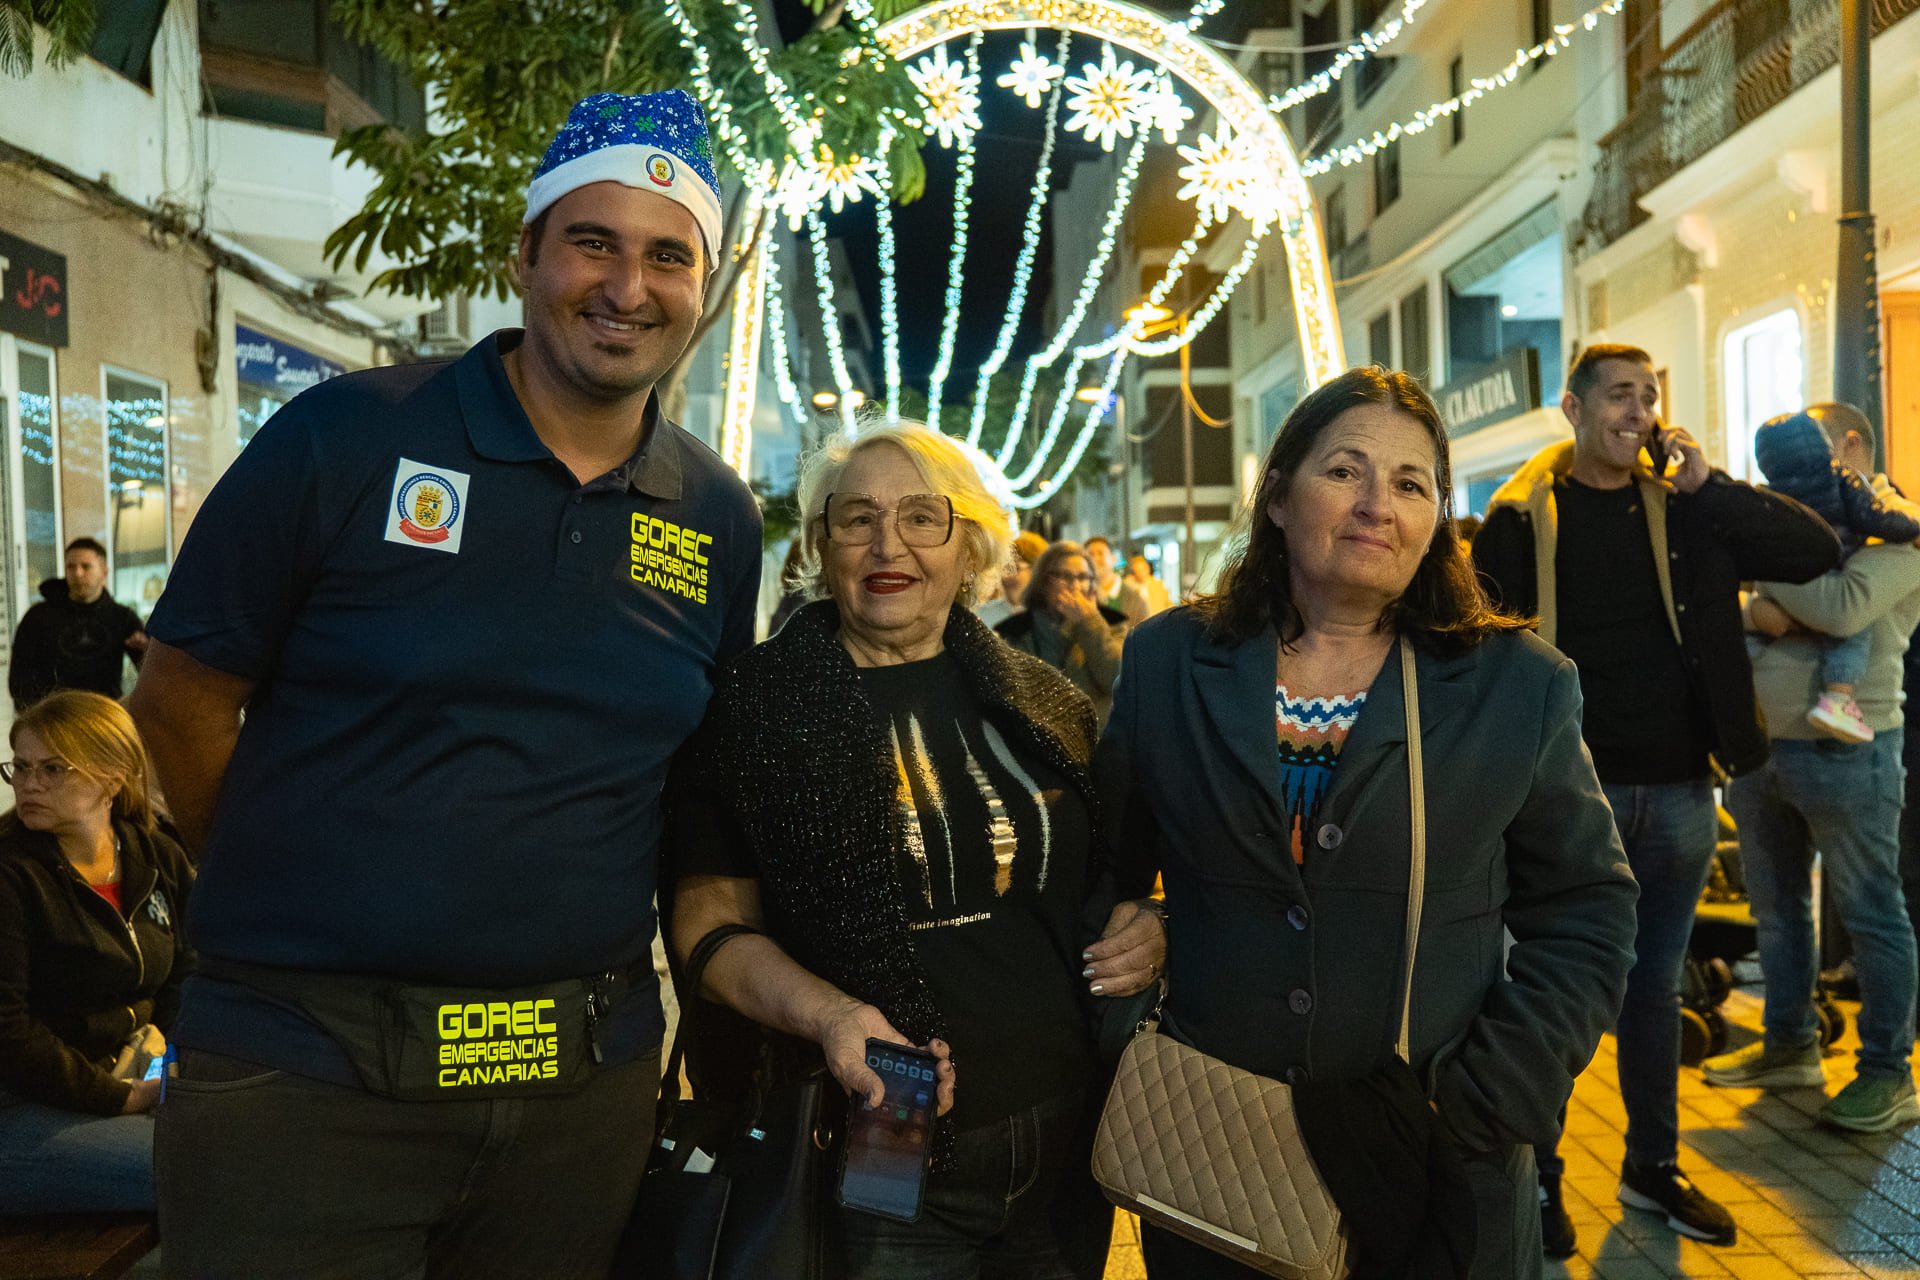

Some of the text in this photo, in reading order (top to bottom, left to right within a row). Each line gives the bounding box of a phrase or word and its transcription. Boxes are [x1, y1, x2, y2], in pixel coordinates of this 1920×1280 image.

[631, 512, 713, 566] GOREC
[631, 543, 708, 586] EMERGENCIAS
[631, 564, 707, 605] CANARIAS
[937, 911, 991, 927] imagination
[438, 999, 557, 1040] GOREC
[439, 1036, 558, 1065] EMERGENCIAS
[439, 1060, 559, 1087] CANARIAS
